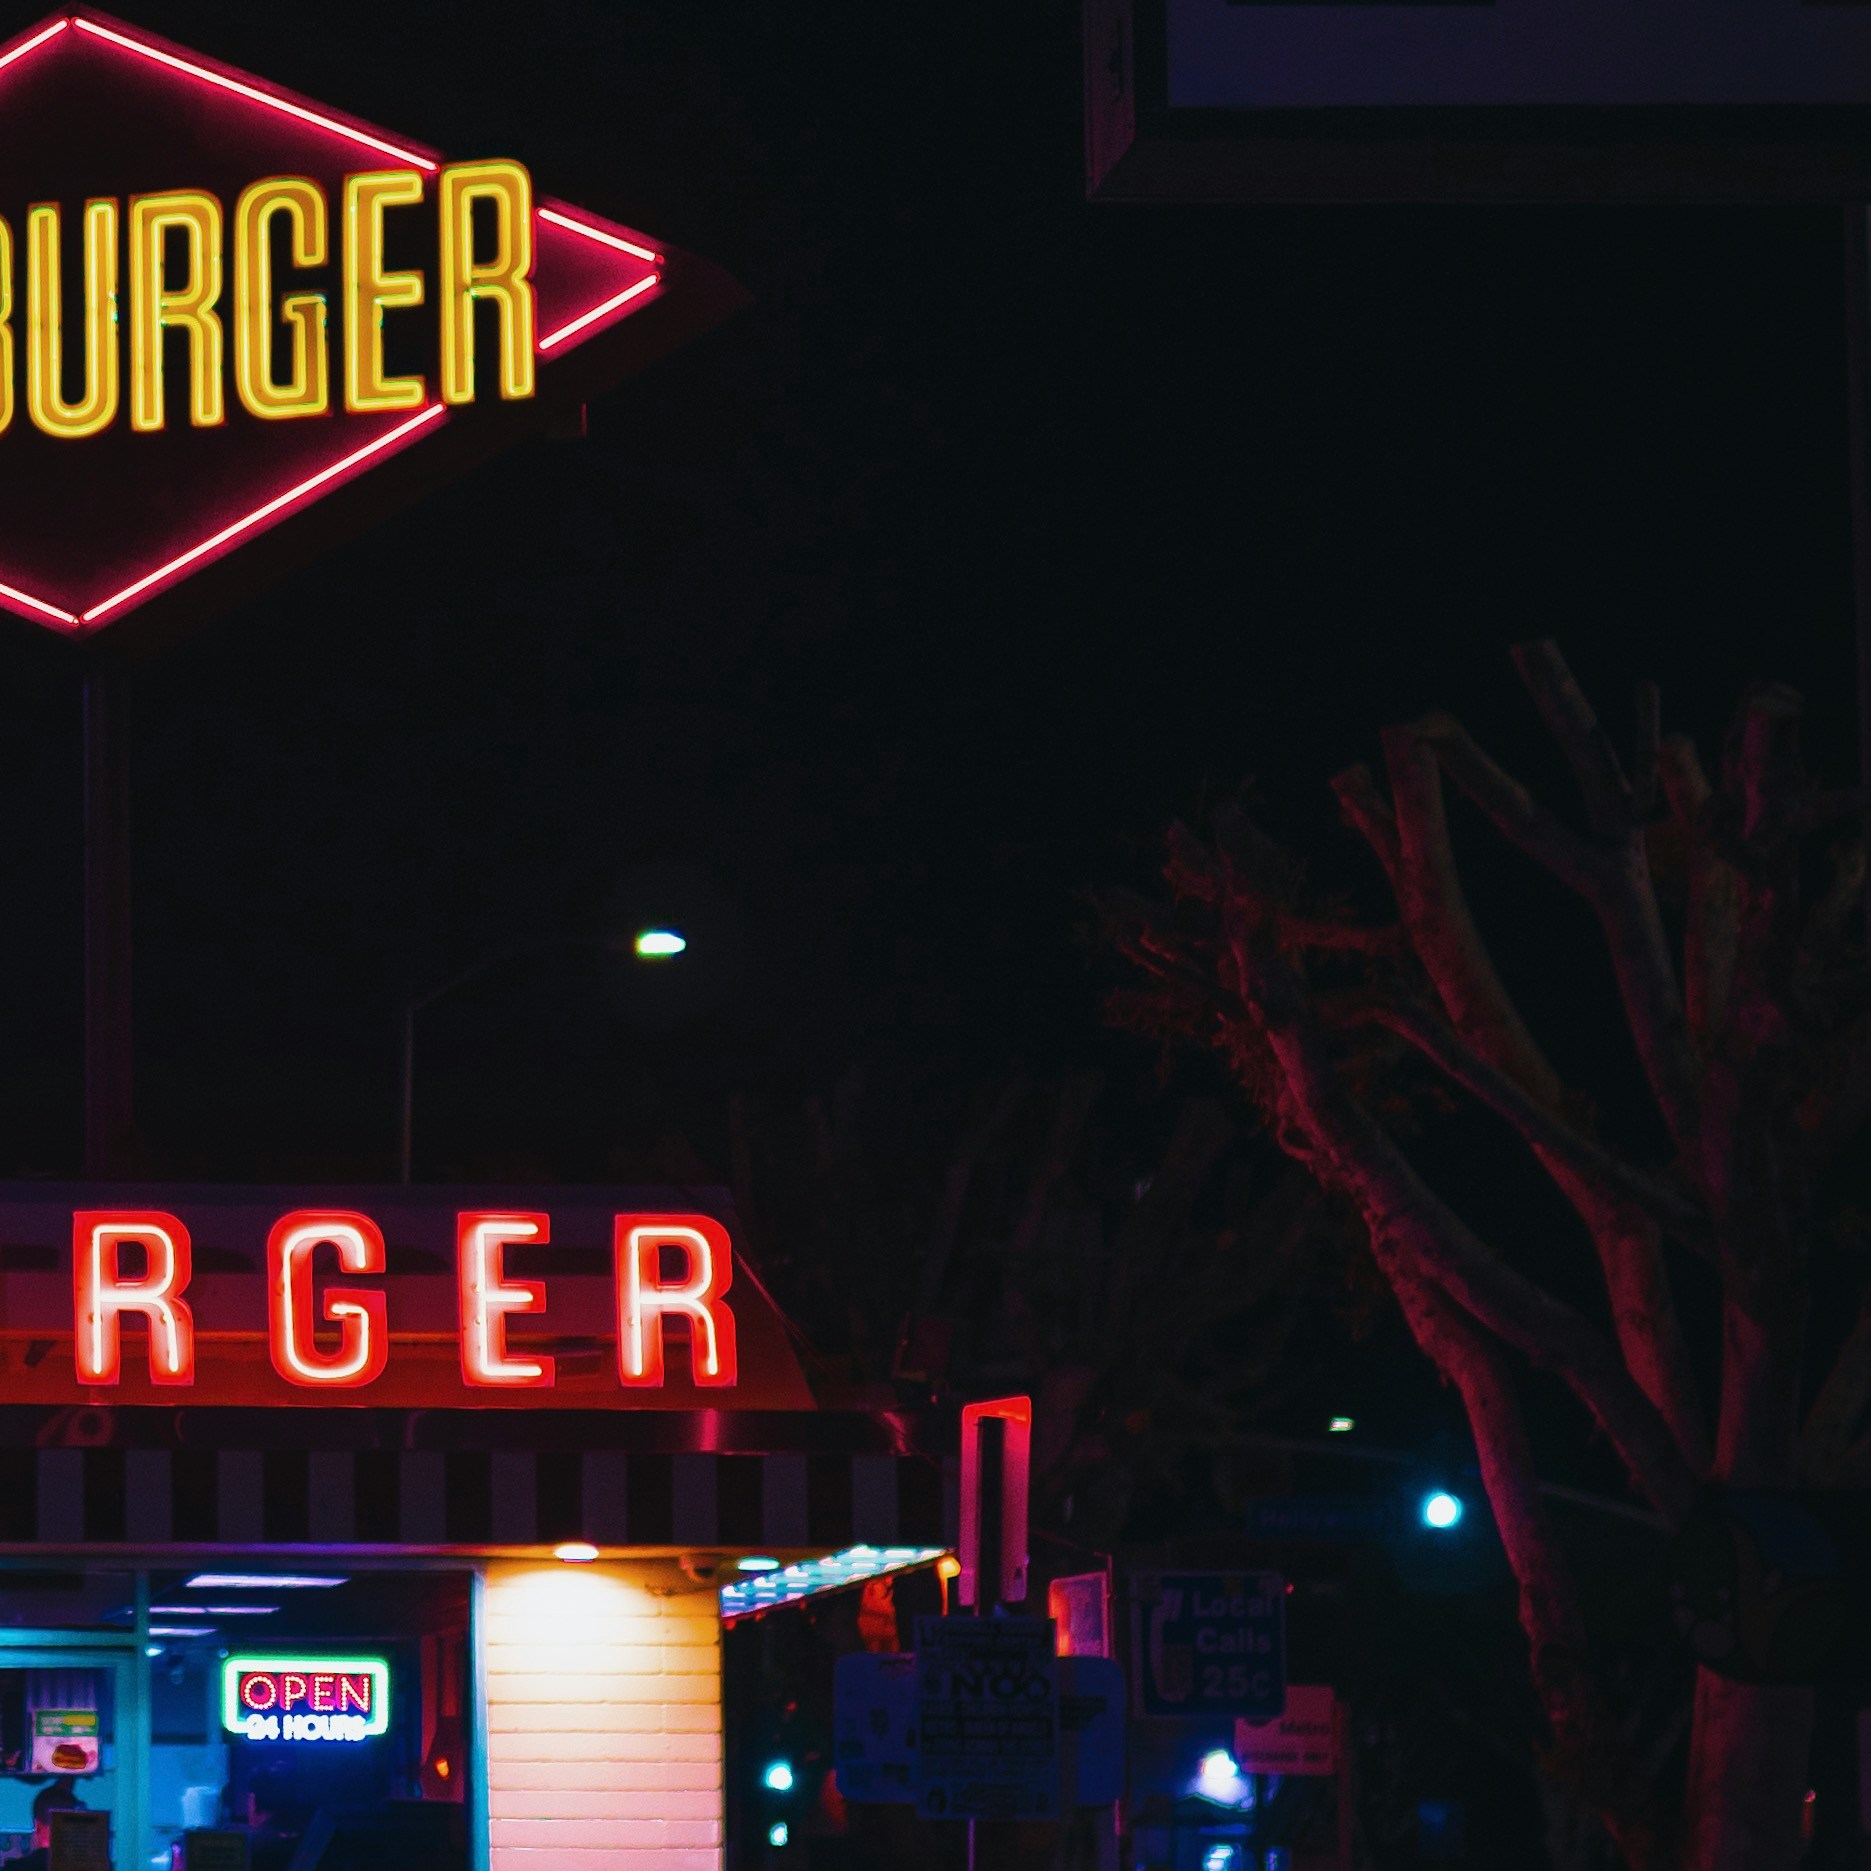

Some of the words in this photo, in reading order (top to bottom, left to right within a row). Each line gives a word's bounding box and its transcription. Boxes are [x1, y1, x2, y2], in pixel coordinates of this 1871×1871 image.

[1192, 1588, 1275, 1618] Local
[1196, 1625, 1272, 1655] Calls
[241, 1672, 370, 1712] OPEN
